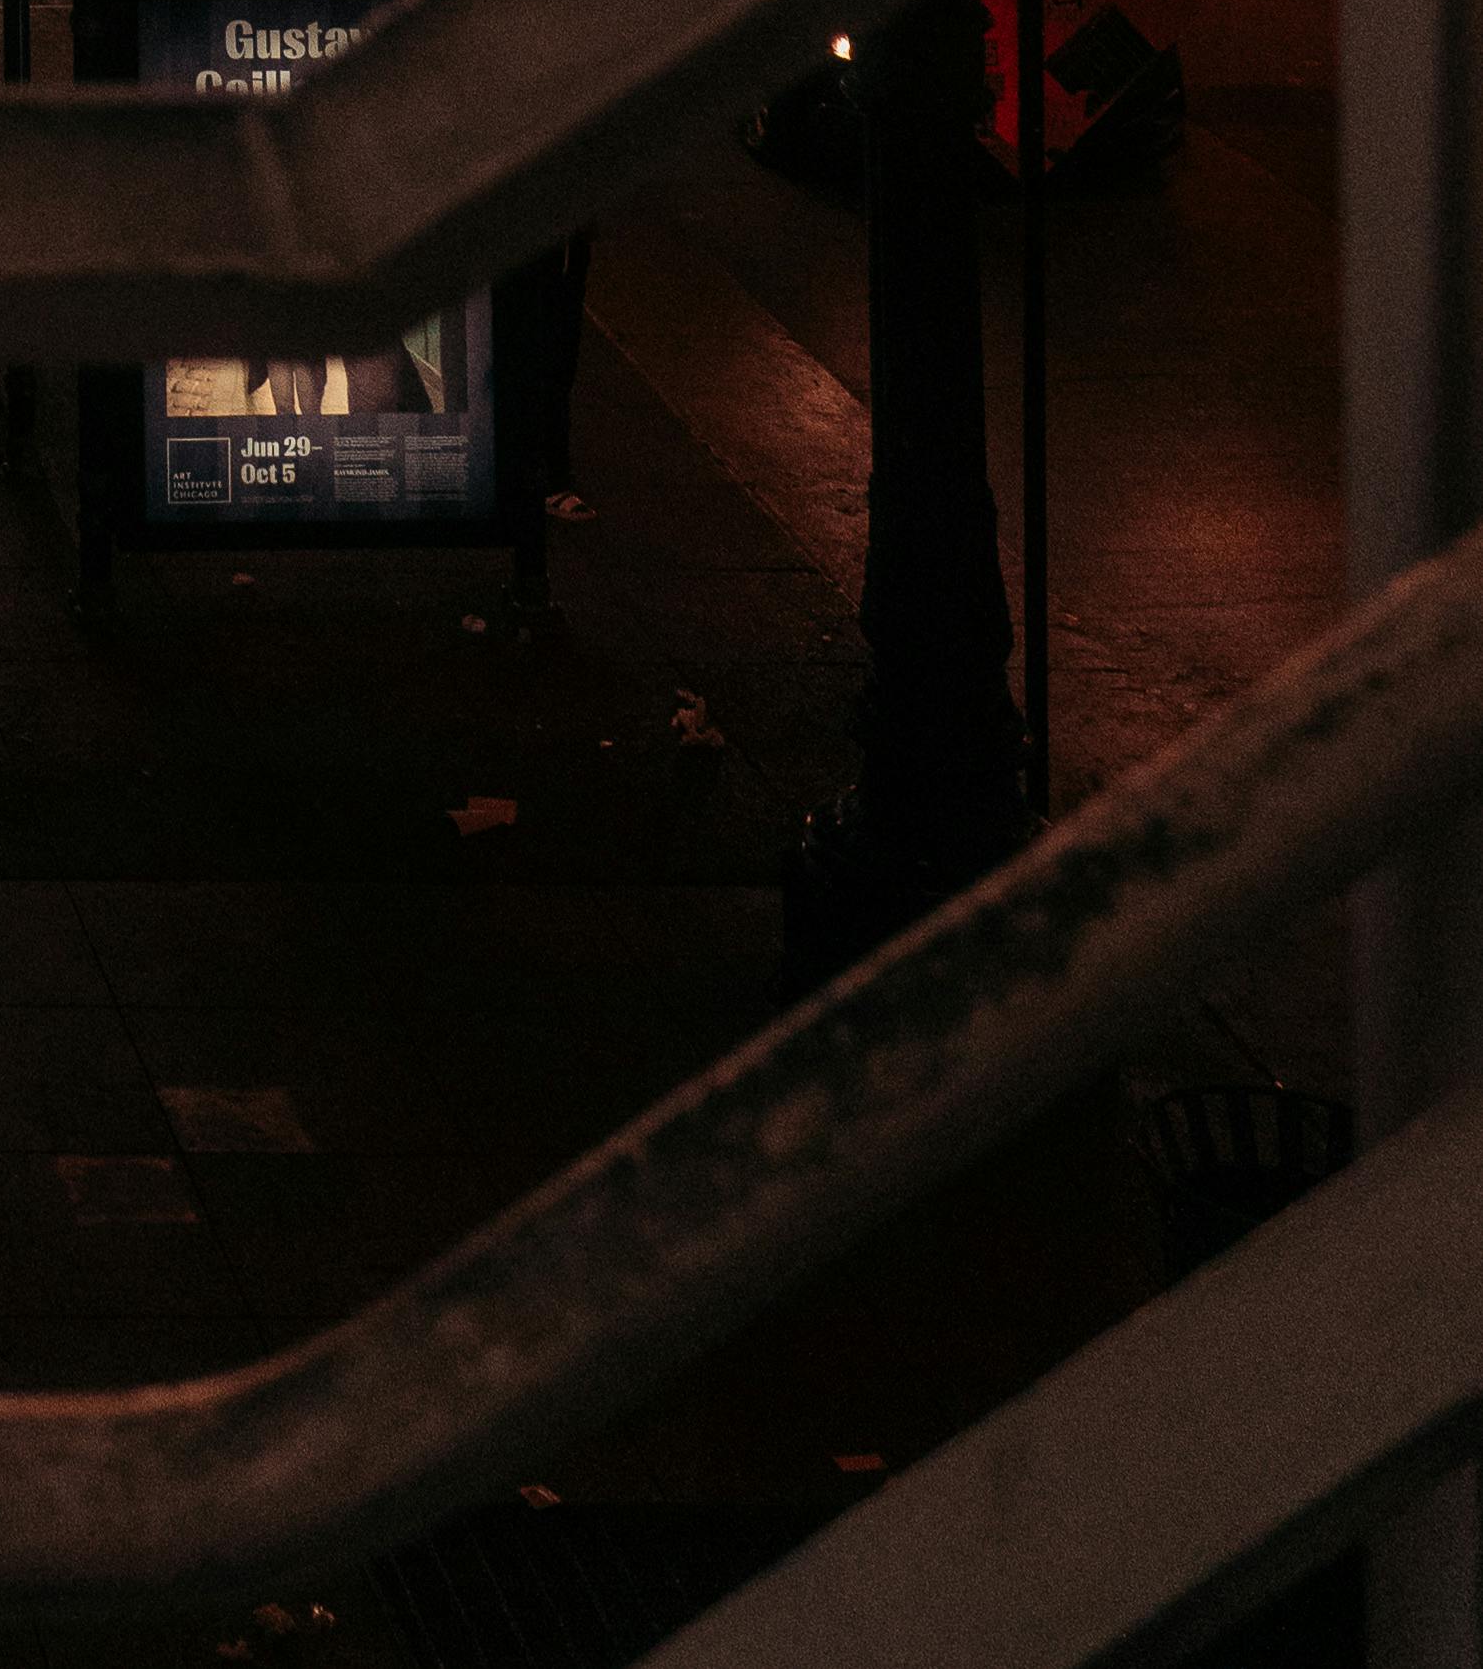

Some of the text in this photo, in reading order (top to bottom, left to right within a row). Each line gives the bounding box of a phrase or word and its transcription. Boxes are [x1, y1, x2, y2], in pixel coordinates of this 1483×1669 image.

[240, 437, 280, 458] Jun
[173, 471, 191, 480] ART
[240, 463, 296, 484] Oct 5
[172, 490, 218, 500] CHICAGO
